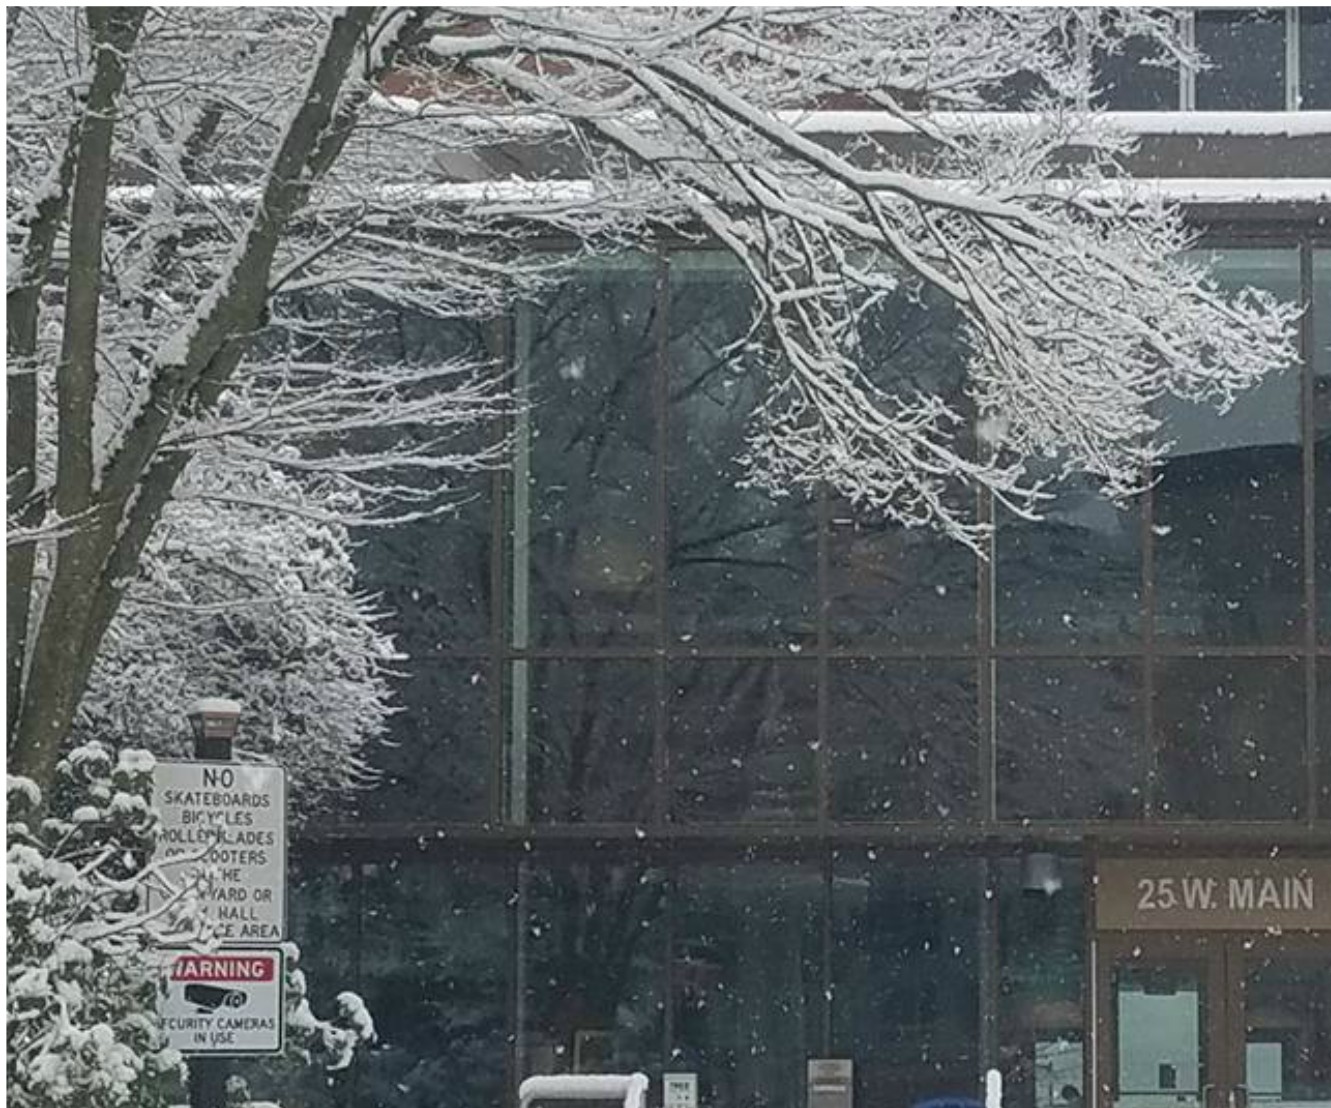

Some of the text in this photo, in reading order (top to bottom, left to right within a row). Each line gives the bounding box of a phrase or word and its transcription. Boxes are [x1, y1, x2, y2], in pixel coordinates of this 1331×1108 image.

[203, 767, 234, 788] NO
[164, 790, 270, 808] SKATEBOARDS
[253, 888, 273, 903] OR
[1137, 876, 1314, 910] 25 W. MAIN
[218, 906, 258, 920] HALL
[239, 924, 281, 938] AREA
[216, 1017, 275, 1031] CAMERAS
[194, 1032, 236, 1047] IN USE
